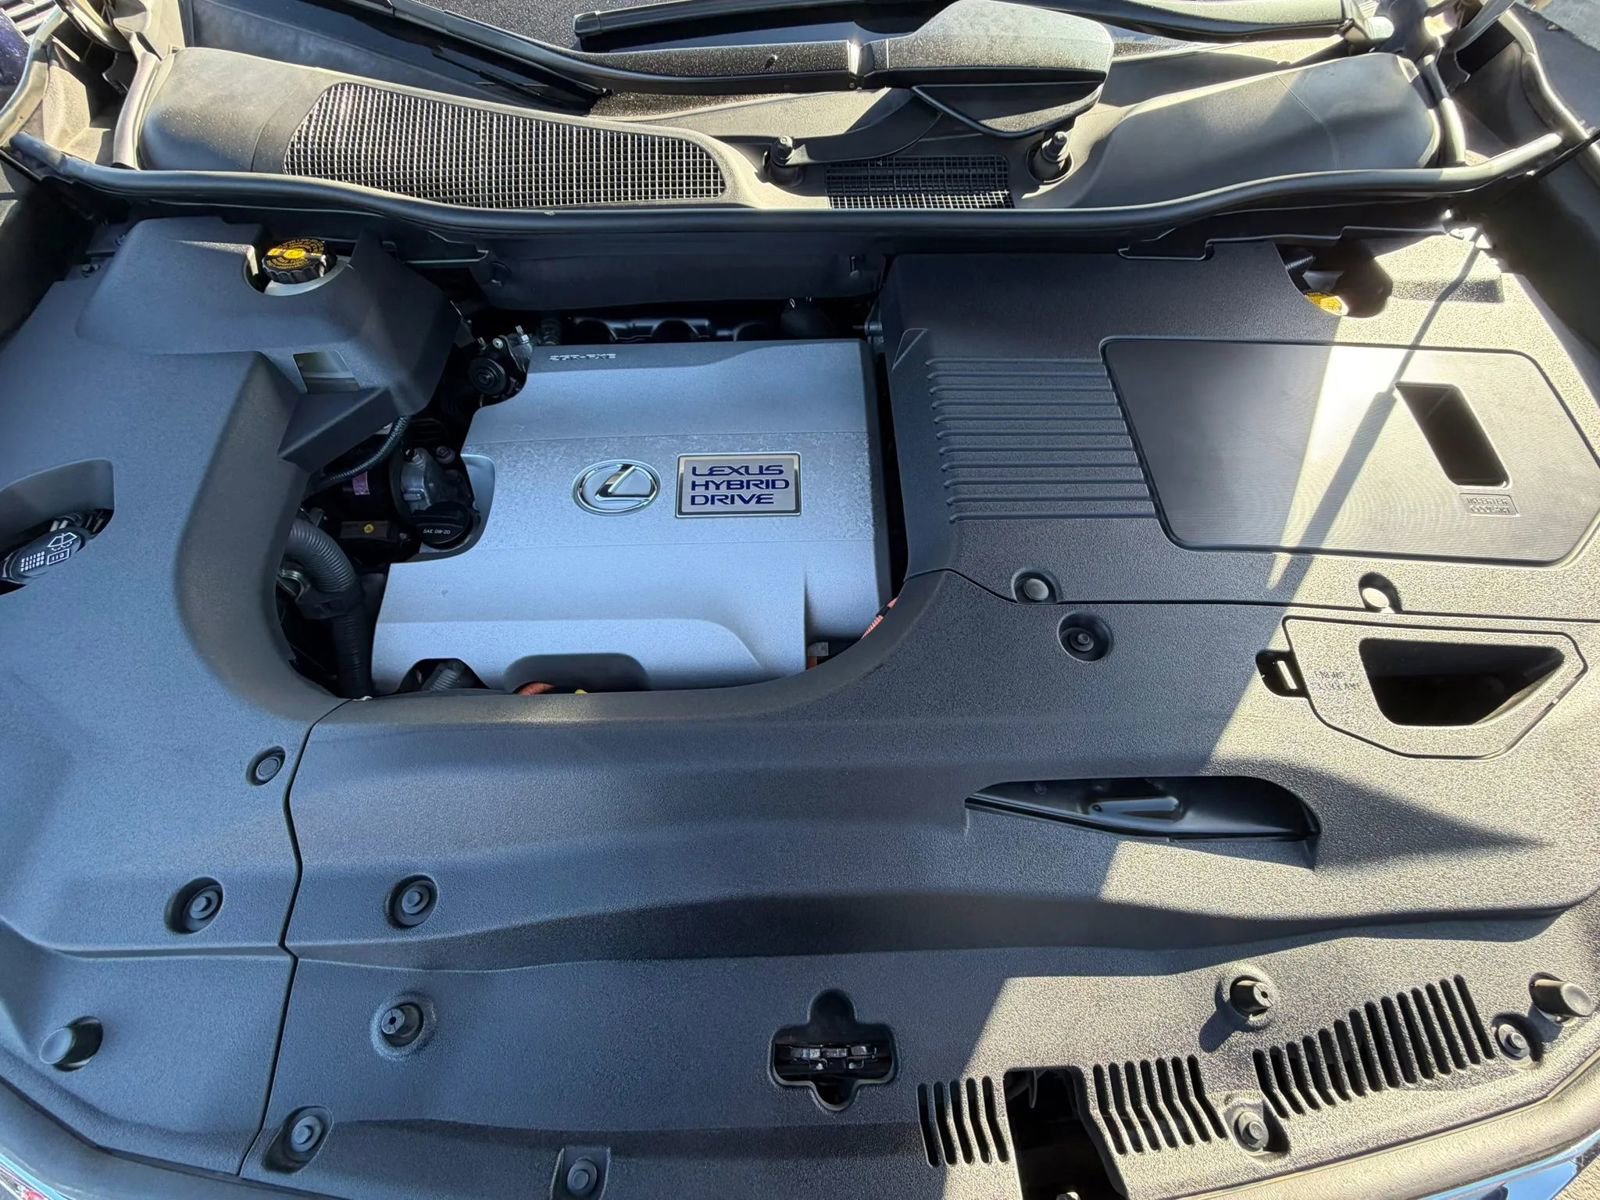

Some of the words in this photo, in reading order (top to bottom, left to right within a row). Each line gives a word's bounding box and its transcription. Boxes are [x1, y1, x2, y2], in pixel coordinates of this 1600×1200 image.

[691, 464, 785, 477] LEXUS
[690, 478, 790, 491] HYBRID
[690, 493, 775, 506] DRIVE
